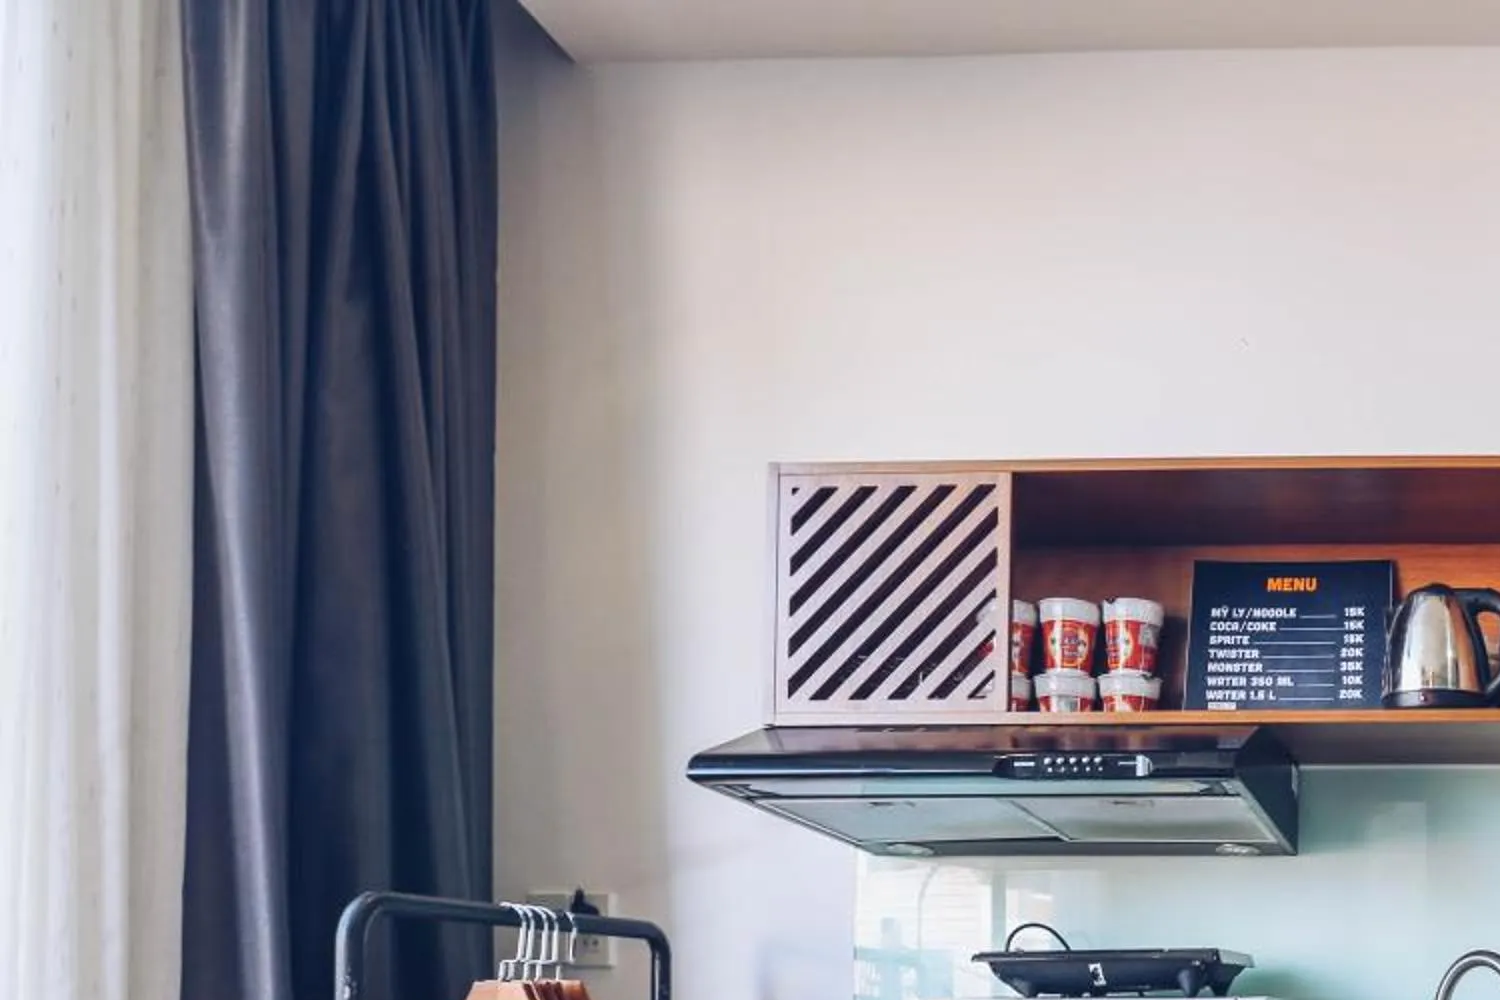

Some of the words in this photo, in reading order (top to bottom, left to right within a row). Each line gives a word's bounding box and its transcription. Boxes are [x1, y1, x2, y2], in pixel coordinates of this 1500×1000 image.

[1267, 577, 1317, 593] MENU
[1209, 635, 1250, 645] SPRITE
[1208, 649, 1259, 659] TWISTER
[1207, 662, 1263, 673] MONSTER
[1207, 676, 1247, 687] WATER
[1206, 689, 1247, 700] WATER
[1268, 690, 1277, 700] L
